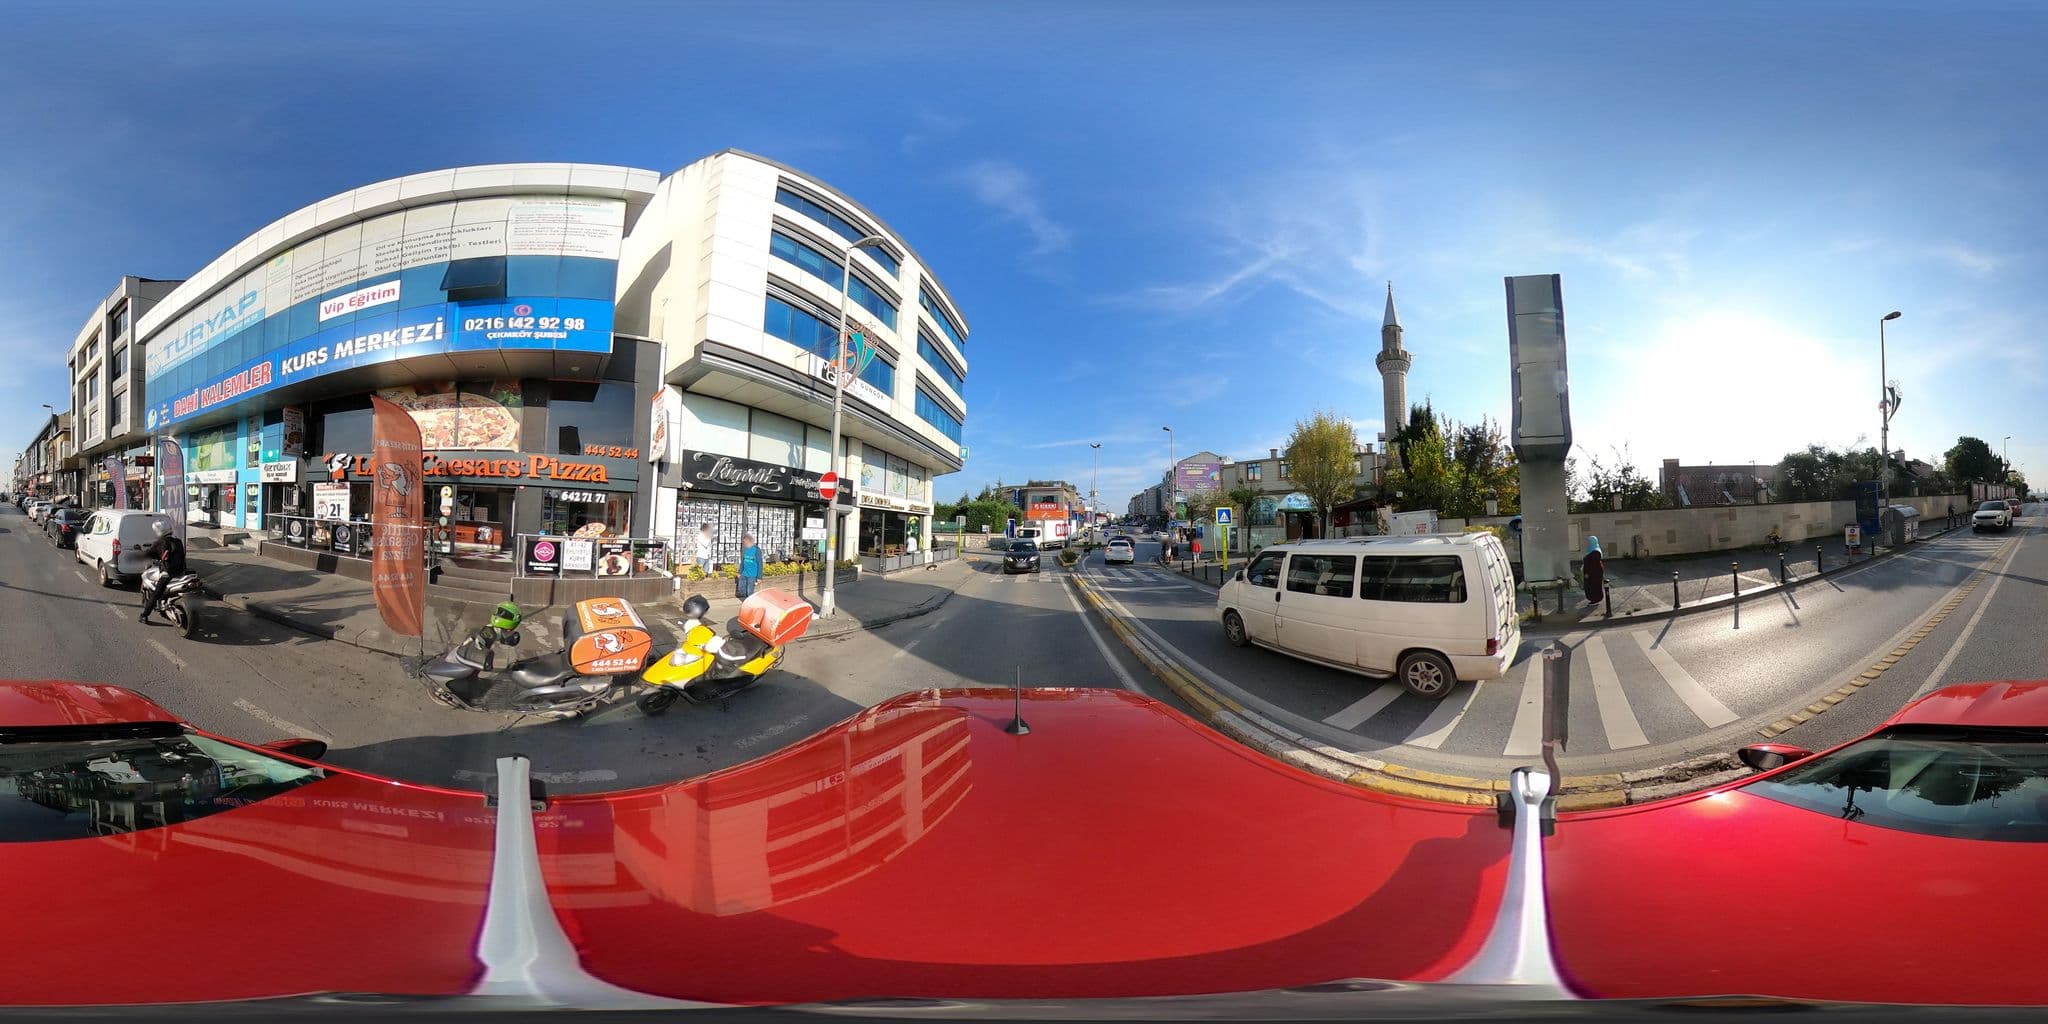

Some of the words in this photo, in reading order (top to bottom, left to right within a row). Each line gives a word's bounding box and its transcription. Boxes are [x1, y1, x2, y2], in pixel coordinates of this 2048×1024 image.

[323, 302, 345, 315] Vip
[348, 286, 396, 308] Eğitim
[164, 290, 258, 360] TURYAP
[464, 317, 504, 332] 0216
[539, 317, 560, 330] 92
[564, 318, 585, 330] 98
[174, 388, 199, 418] DAHİ
[201, 361, 272, 408] KALEMLER
[281, 346, 328, 376] KURS
[334, 316, 444, 360] MERKEZİ
[584, 444, 606, 456] 444
[608, 446, 623, 458] 52
[624, 448, 639, 460] 44
[422, 453, 522, 478] Caesars
[526, 454, 609, 484] Pizza
[561, 491, 581, 502] 642
[582, 492, 592, 503] 71
[594, 493, 606, 504] 71
[330, 503, 340, 517] 21
[624, 657, 638, 665] 44
